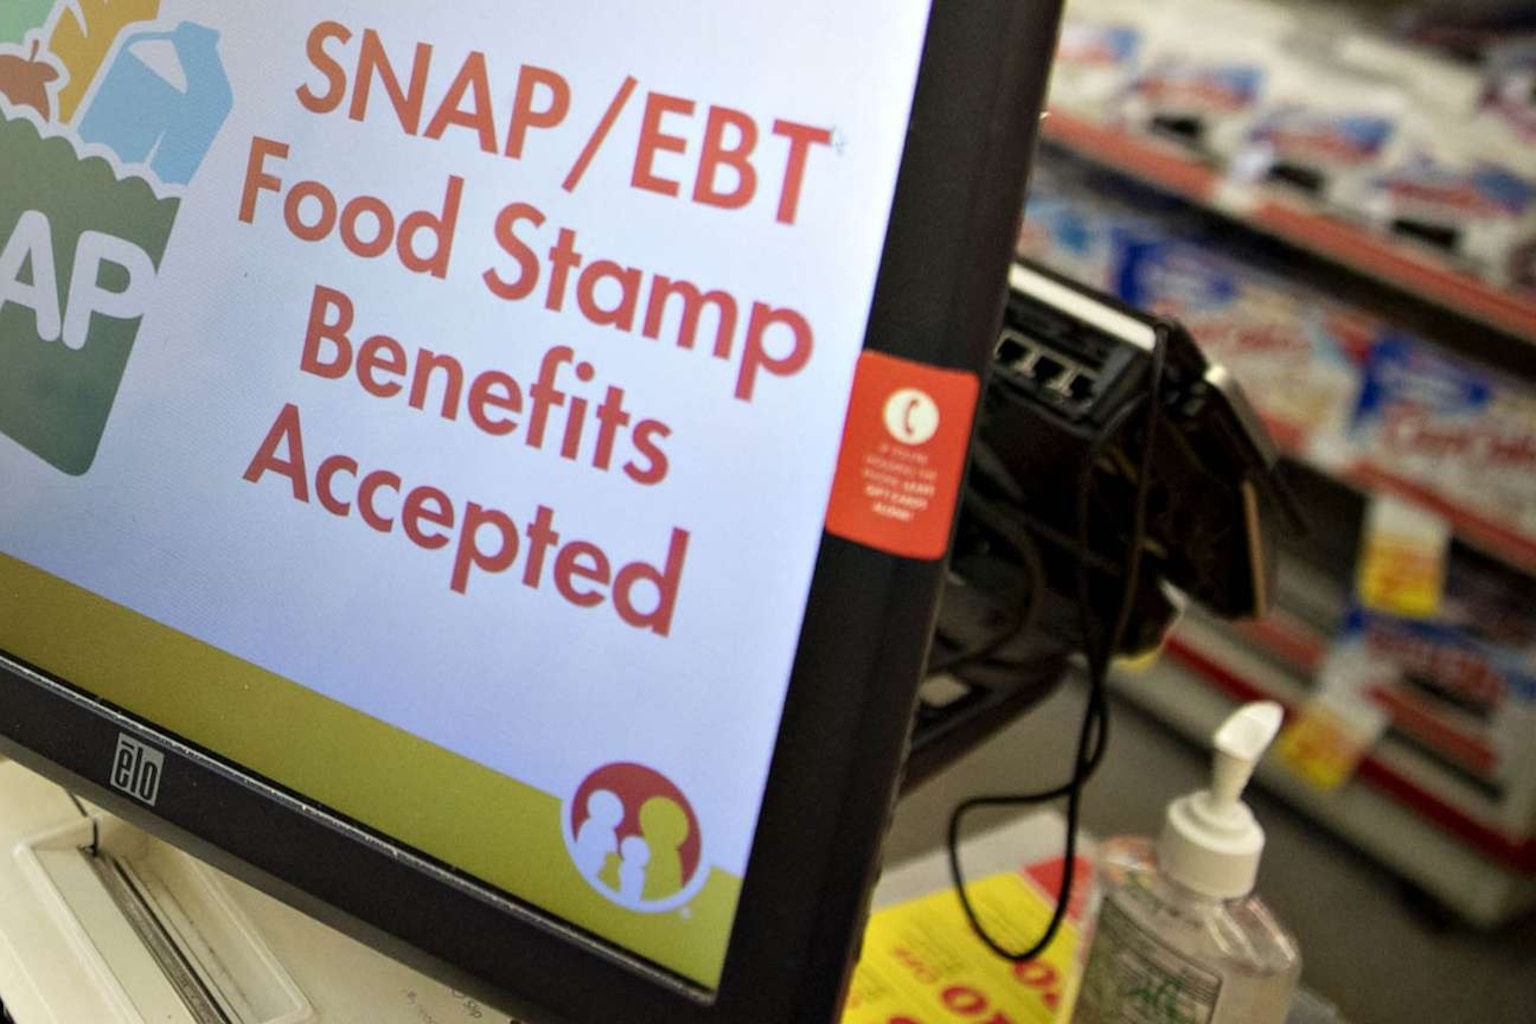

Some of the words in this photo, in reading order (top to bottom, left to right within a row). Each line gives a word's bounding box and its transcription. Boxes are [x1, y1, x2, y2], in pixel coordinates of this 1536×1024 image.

[296, 21, 832, 225] SNAP/EBT
[239, 137, 464, 279] Food
[484, 202, 814, 401] Stamp
[301, 285, 671, 485] Benefits
[245, 404, 689, 636] Accepted
